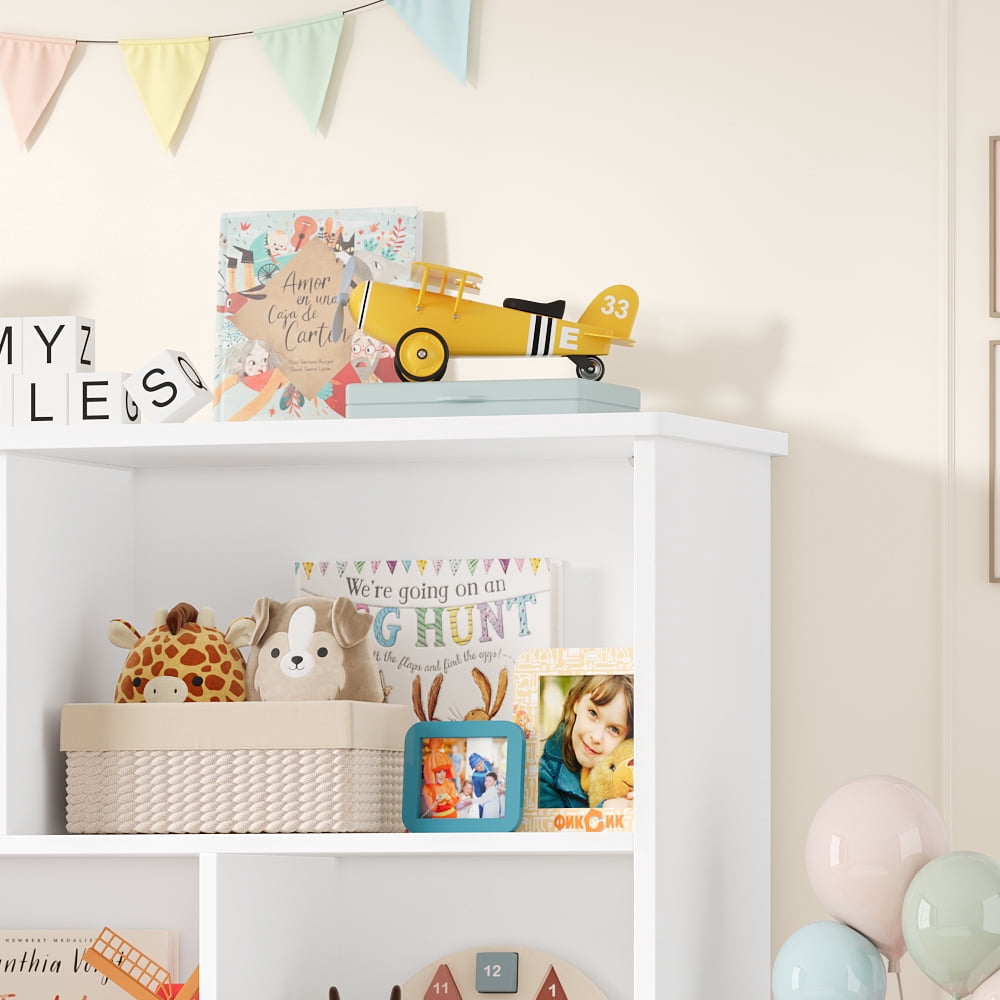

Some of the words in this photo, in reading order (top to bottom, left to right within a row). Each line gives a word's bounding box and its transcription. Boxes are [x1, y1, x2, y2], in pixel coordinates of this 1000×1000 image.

[282, 270, 331, 296] Amor
[268, 304, 297, 329] Caja
[600, 295, 630, 319] 33
[559, 326, 580, 351] E
[346, 577, 392, 598] We're
[399, 583, 449, 605] going
[455, 582, 478, 597] on
[484, 578, 506, 592] an
[414, 593, 537, 648] HUNT
[483, 964, 501, 977] 12
[432, 981, 449, 995] 11
[548, 983, 556, 998] 1
